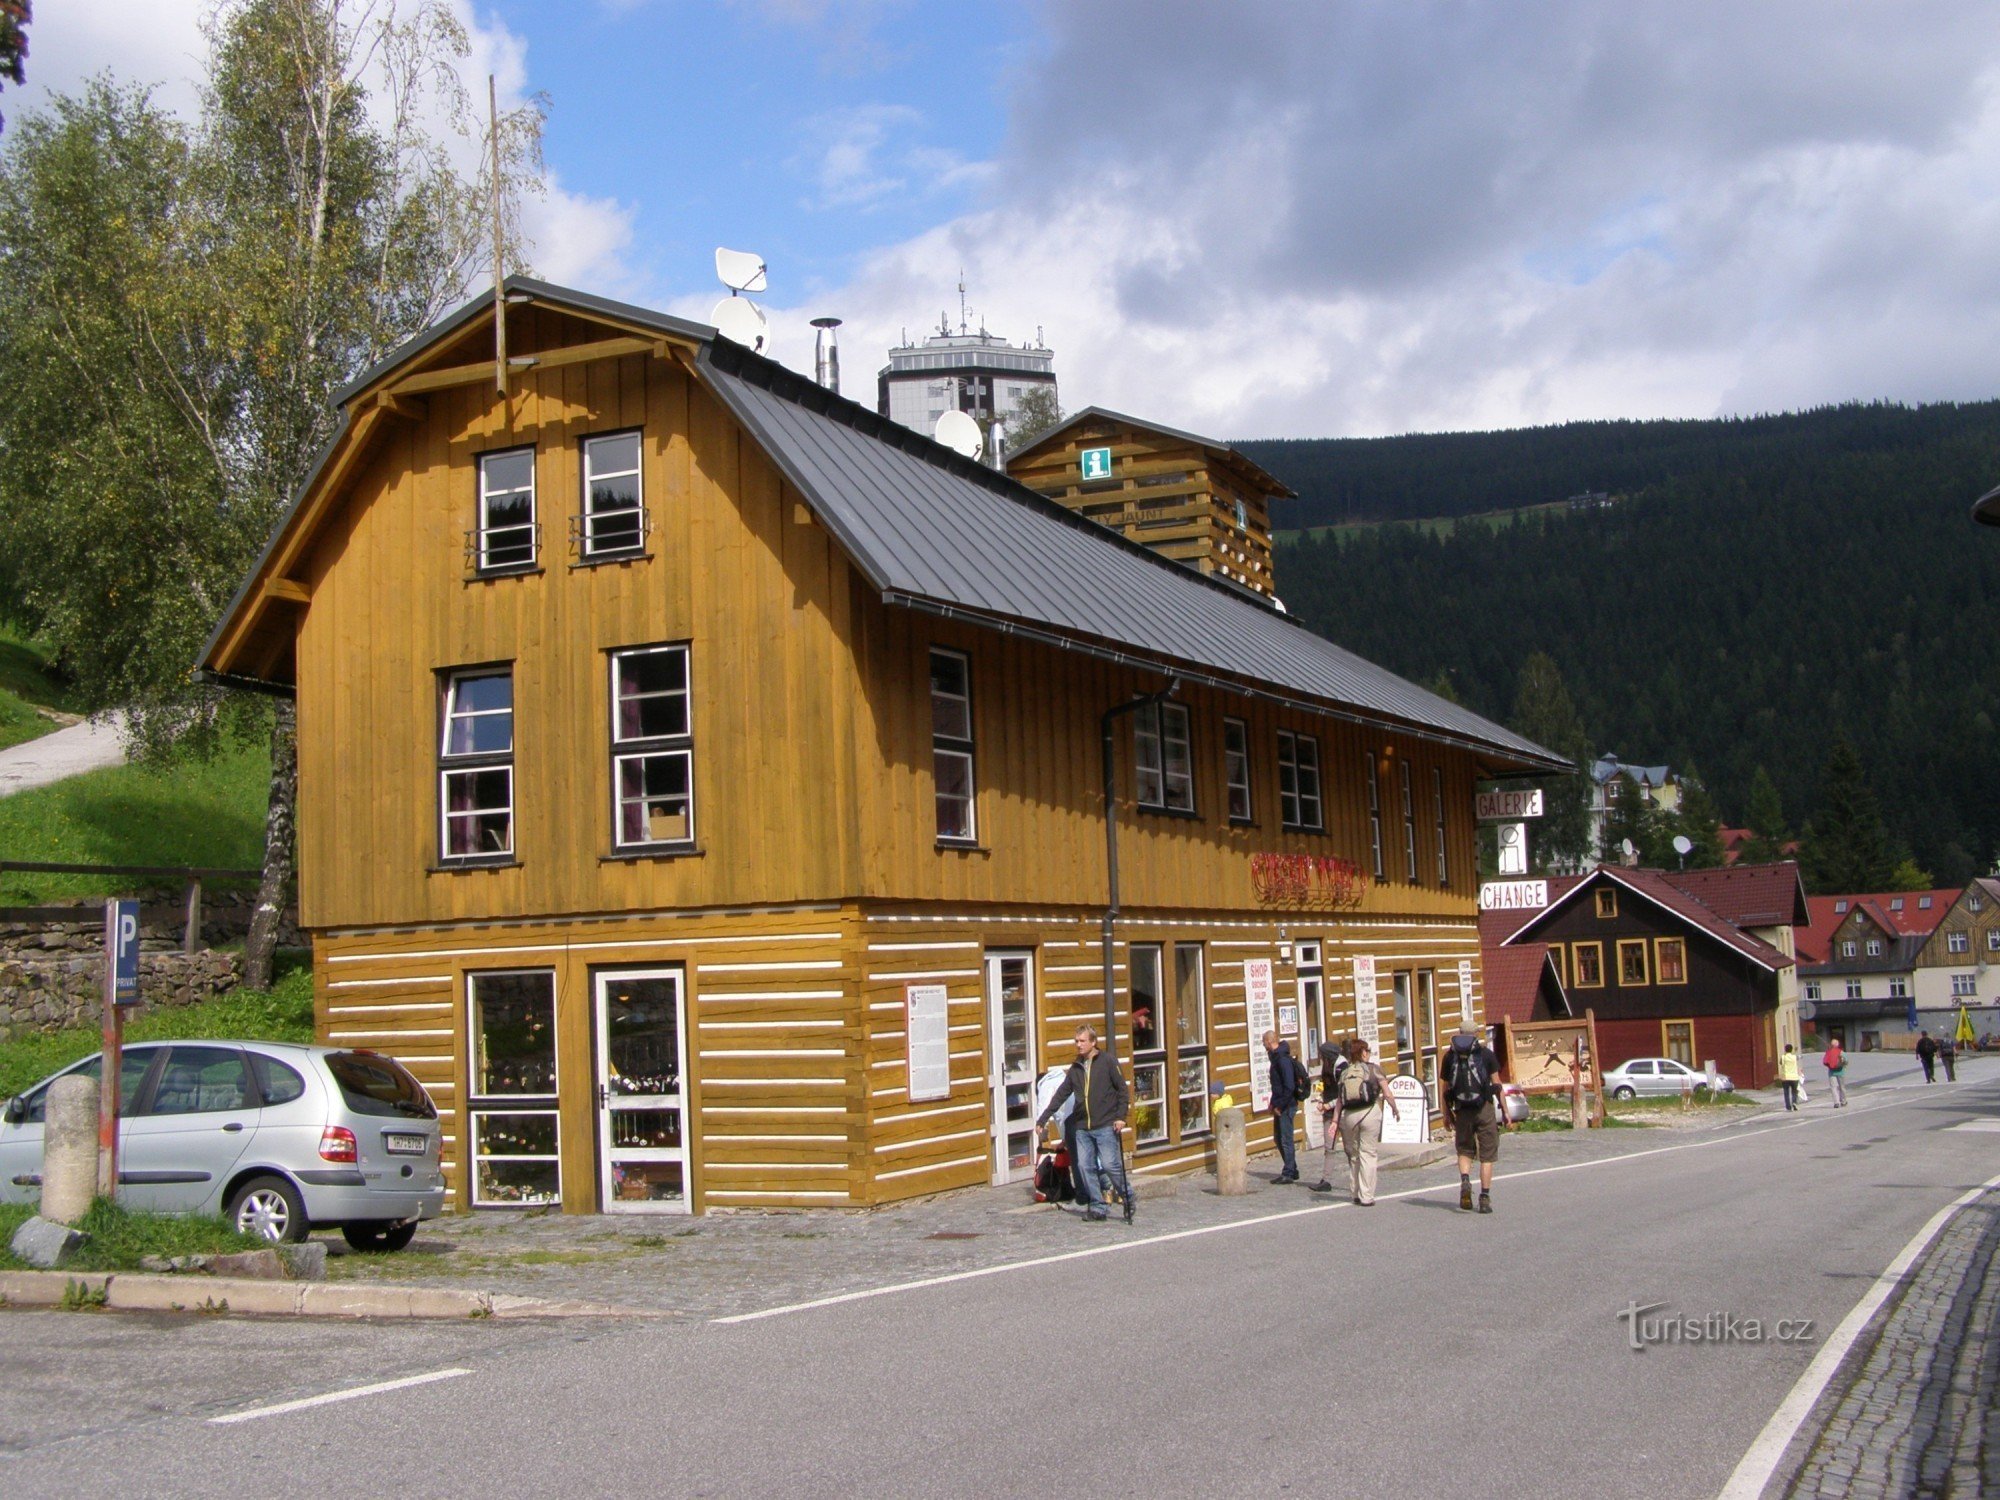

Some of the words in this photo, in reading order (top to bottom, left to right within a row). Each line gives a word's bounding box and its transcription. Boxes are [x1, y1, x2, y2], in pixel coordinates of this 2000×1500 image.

[1118, 509, 1163, 523] JAUNT
[1479, 793, 1538, 816] GALERIE
[1484, 884, 1543, 908] CHANGE
[120, 914, 136, 958] P
[1250, 964, 1267, 978] SHOP
[117, 977, 137, 987] PRIVAT
[1392, 1080, 1416, 1090] OPEN
